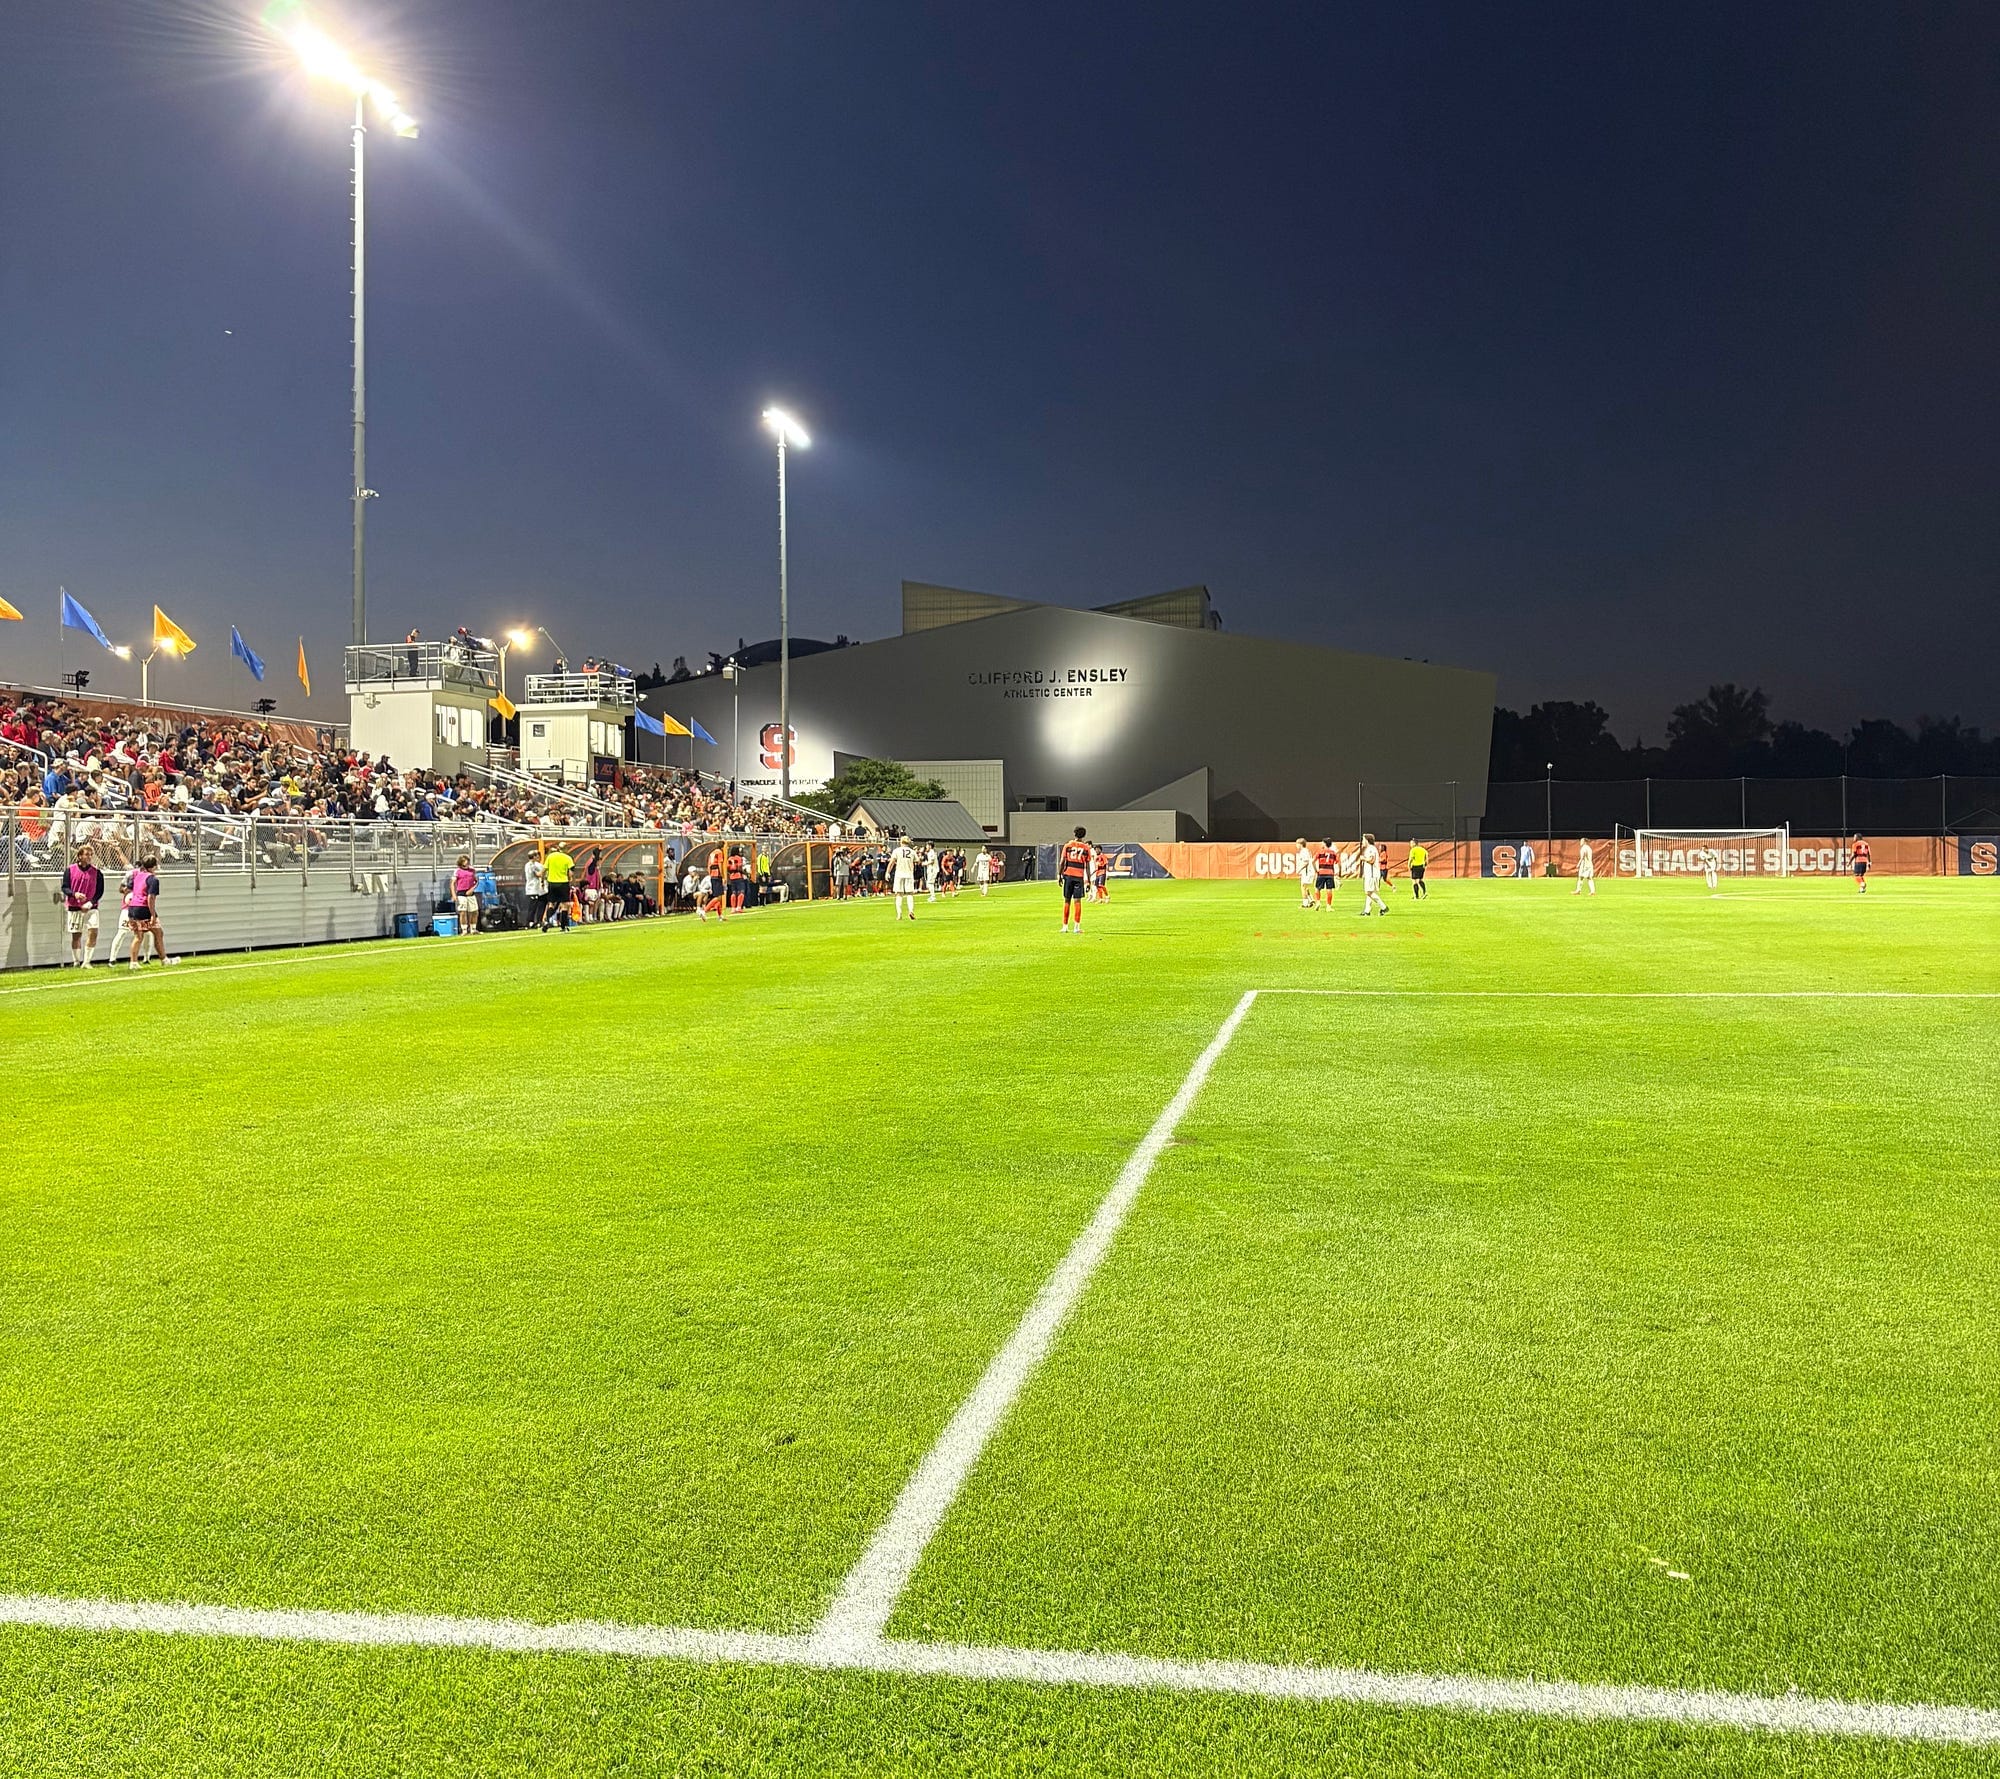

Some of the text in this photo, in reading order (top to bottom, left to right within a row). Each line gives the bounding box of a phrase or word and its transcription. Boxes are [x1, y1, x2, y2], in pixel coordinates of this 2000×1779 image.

[968, 668, 1129, 685] CLIFFORD J. ENSLEY
[1003, 687, 1093, 699] ATHLETIC CENTER
[759, 723, 798, 770] S
[902, 849, 911, 859] 12
[1070, 847, 1084, 860] 27
[1492, 845, 1517, 877] S
[1763, 848, 1853, 872] SOCCE
[1971, 842, 1998, 875] S
